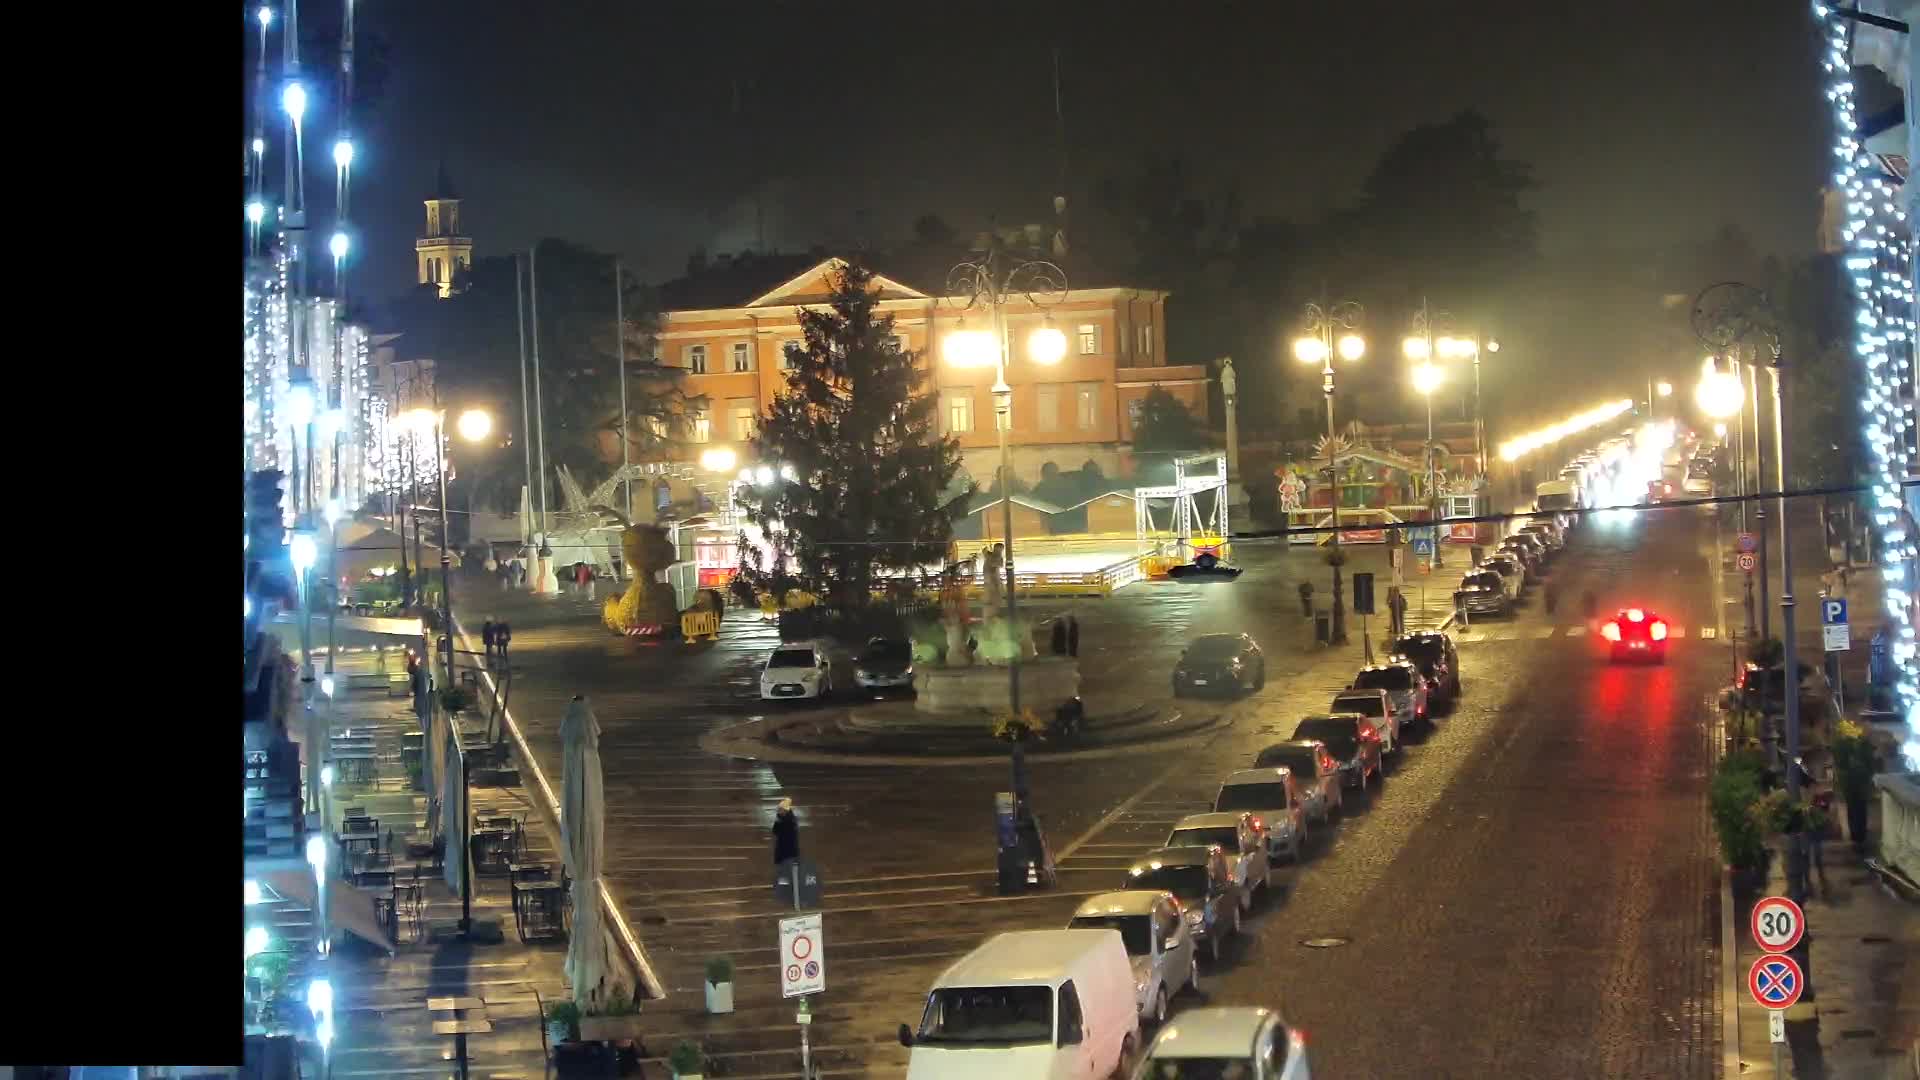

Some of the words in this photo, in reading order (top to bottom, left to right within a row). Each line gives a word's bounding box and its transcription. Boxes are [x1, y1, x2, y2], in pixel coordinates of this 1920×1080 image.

[1743, 557, 1753, 567] 20
[1827, 601, 1842, 622] P
[1762, 912, 1791, 937] 30
